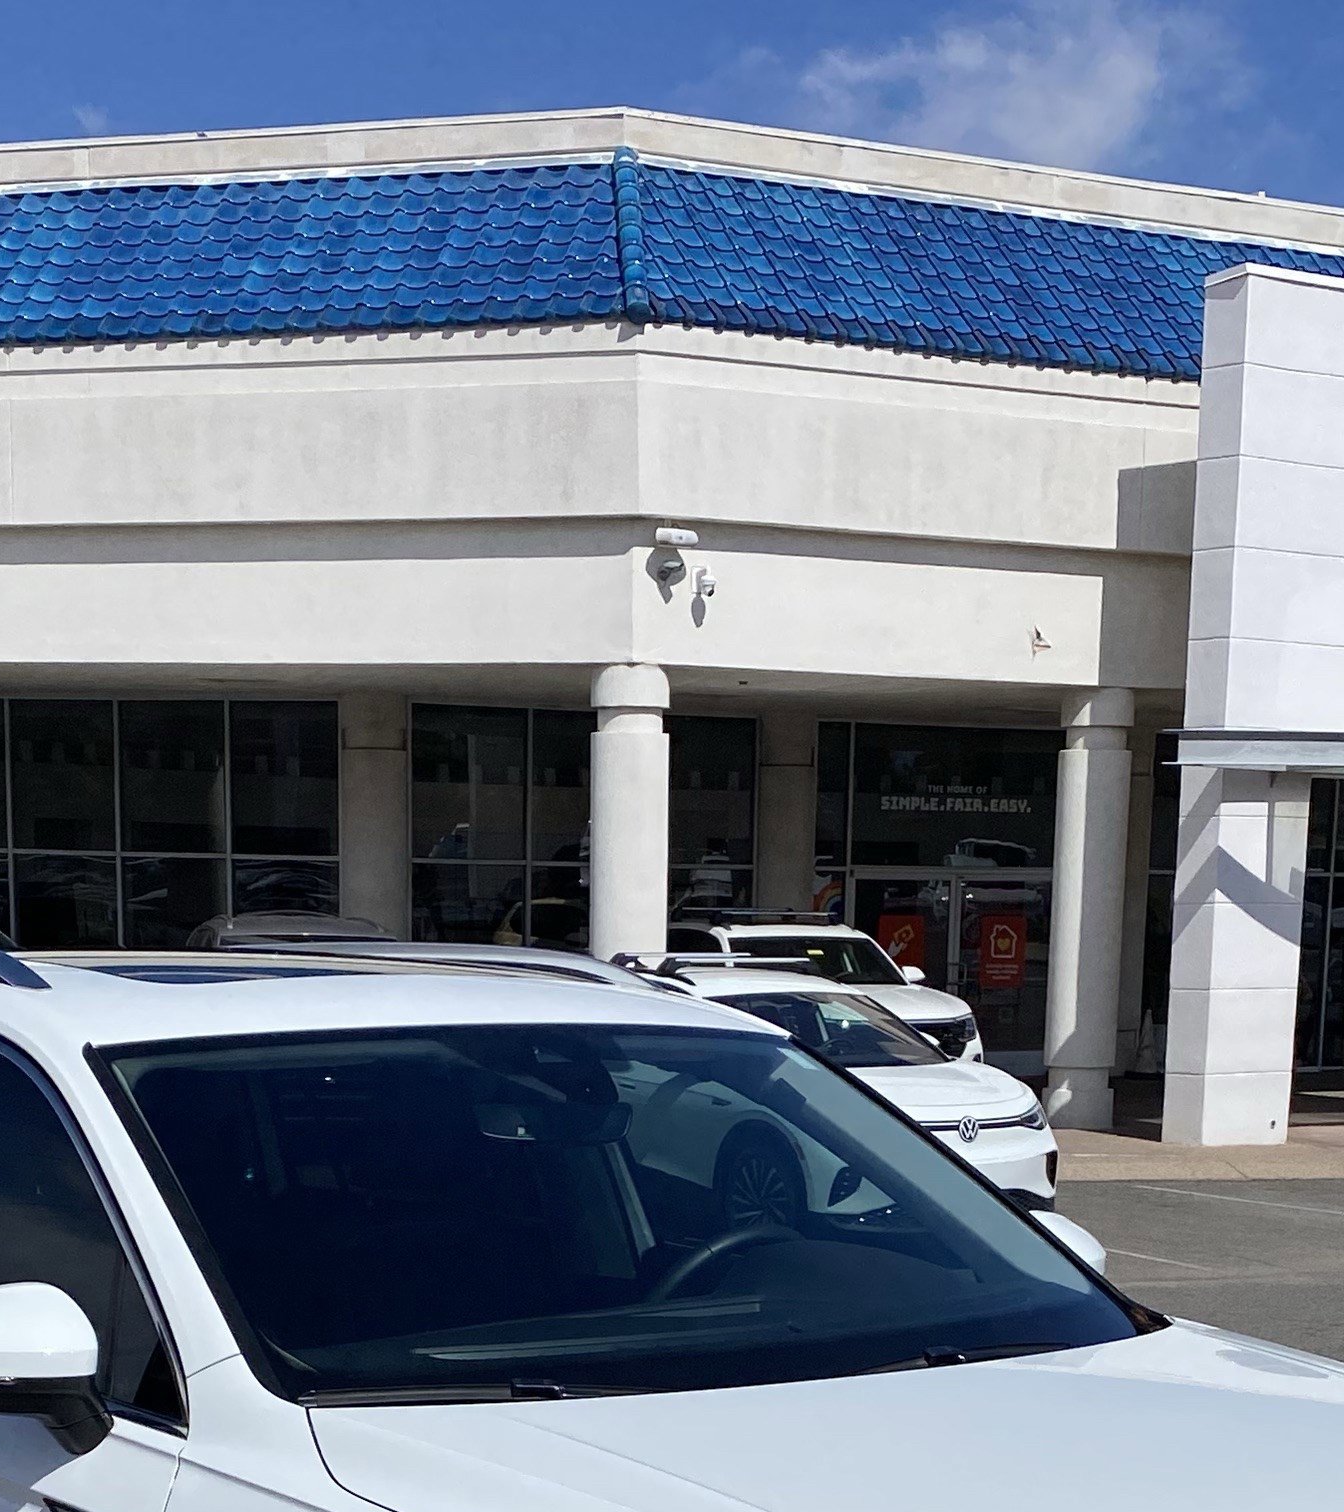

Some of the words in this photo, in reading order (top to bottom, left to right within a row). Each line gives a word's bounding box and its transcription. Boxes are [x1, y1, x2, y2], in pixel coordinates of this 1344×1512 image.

[927, 785, 944, 794] THE
[946, 785, 974, 795] HOME
[976, 786, 988, 795] OF
